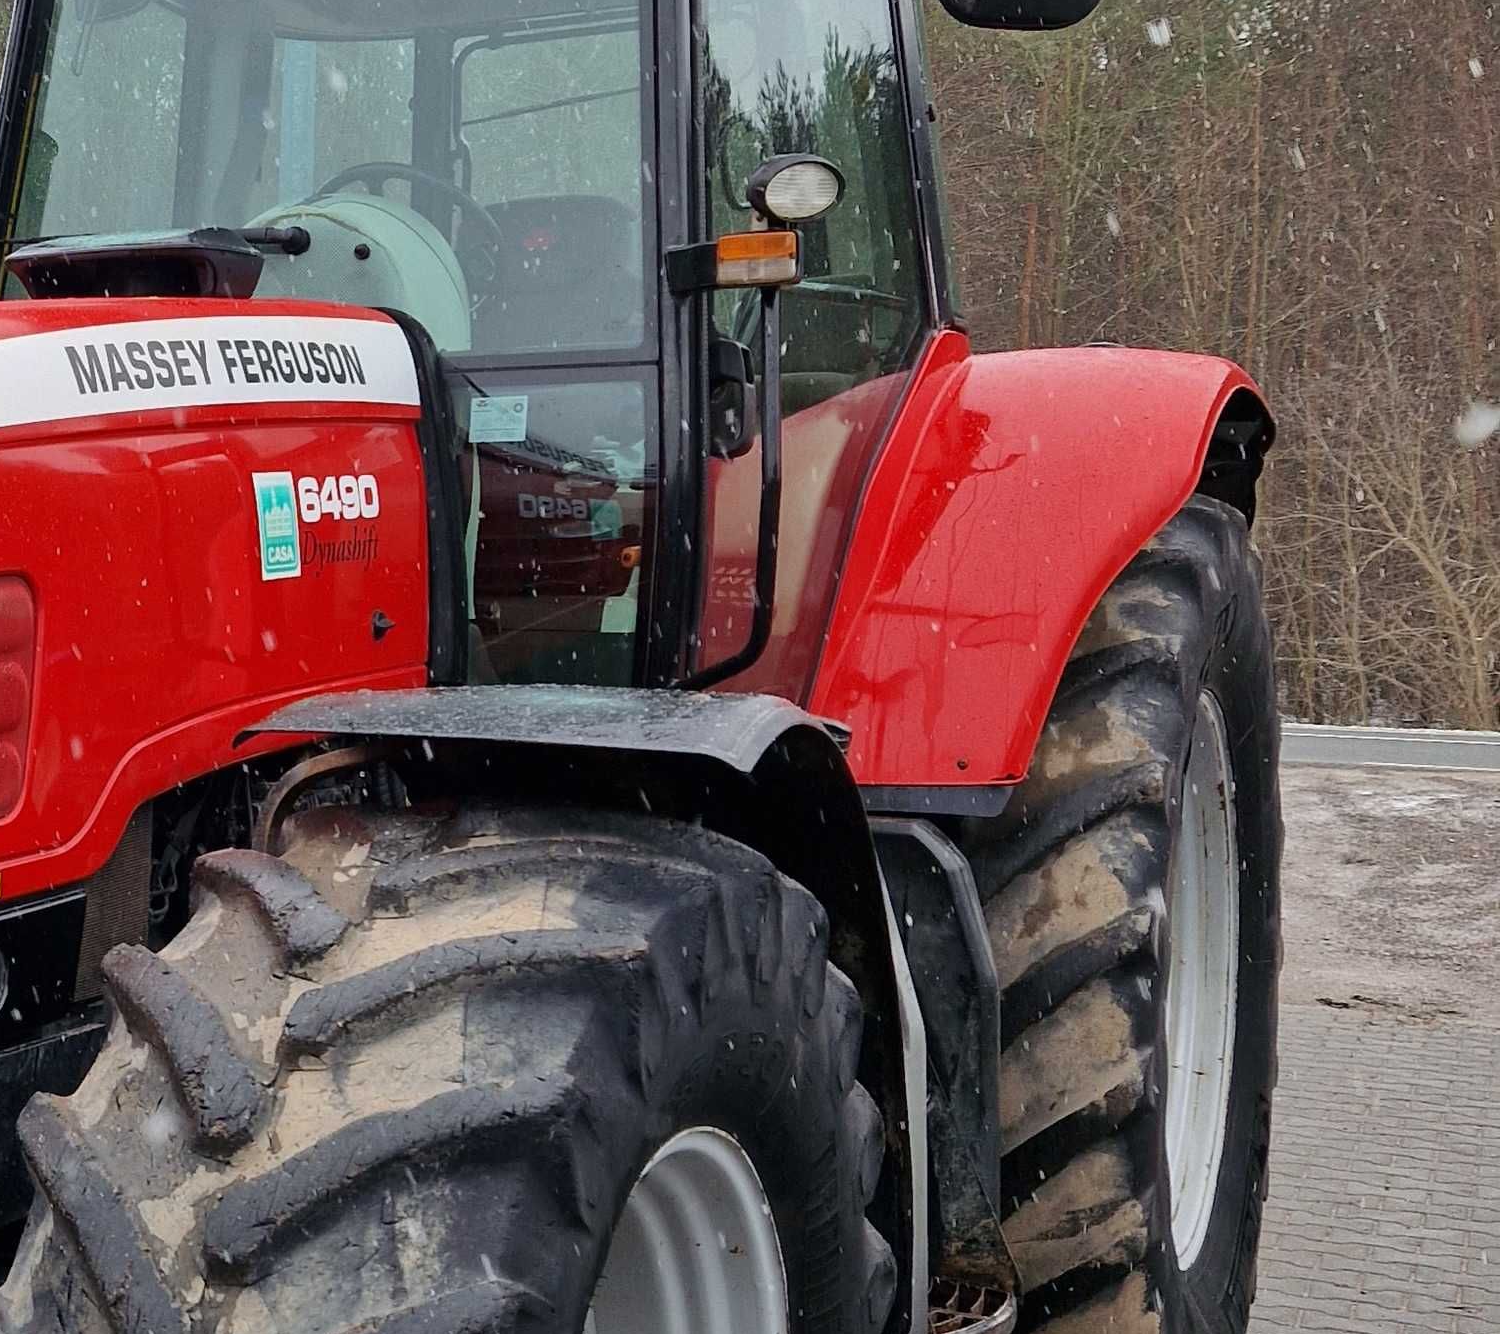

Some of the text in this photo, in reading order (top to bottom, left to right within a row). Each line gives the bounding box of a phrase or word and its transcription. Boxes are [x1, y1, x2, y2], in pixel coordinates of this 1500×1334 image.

[64, 339, 367, 395] MASSEY FERGUSON
[298, 474, 380, 523] 6490
[267, 545, 295, 563] CASA
[301, 525, 379, 572] Dynashift
